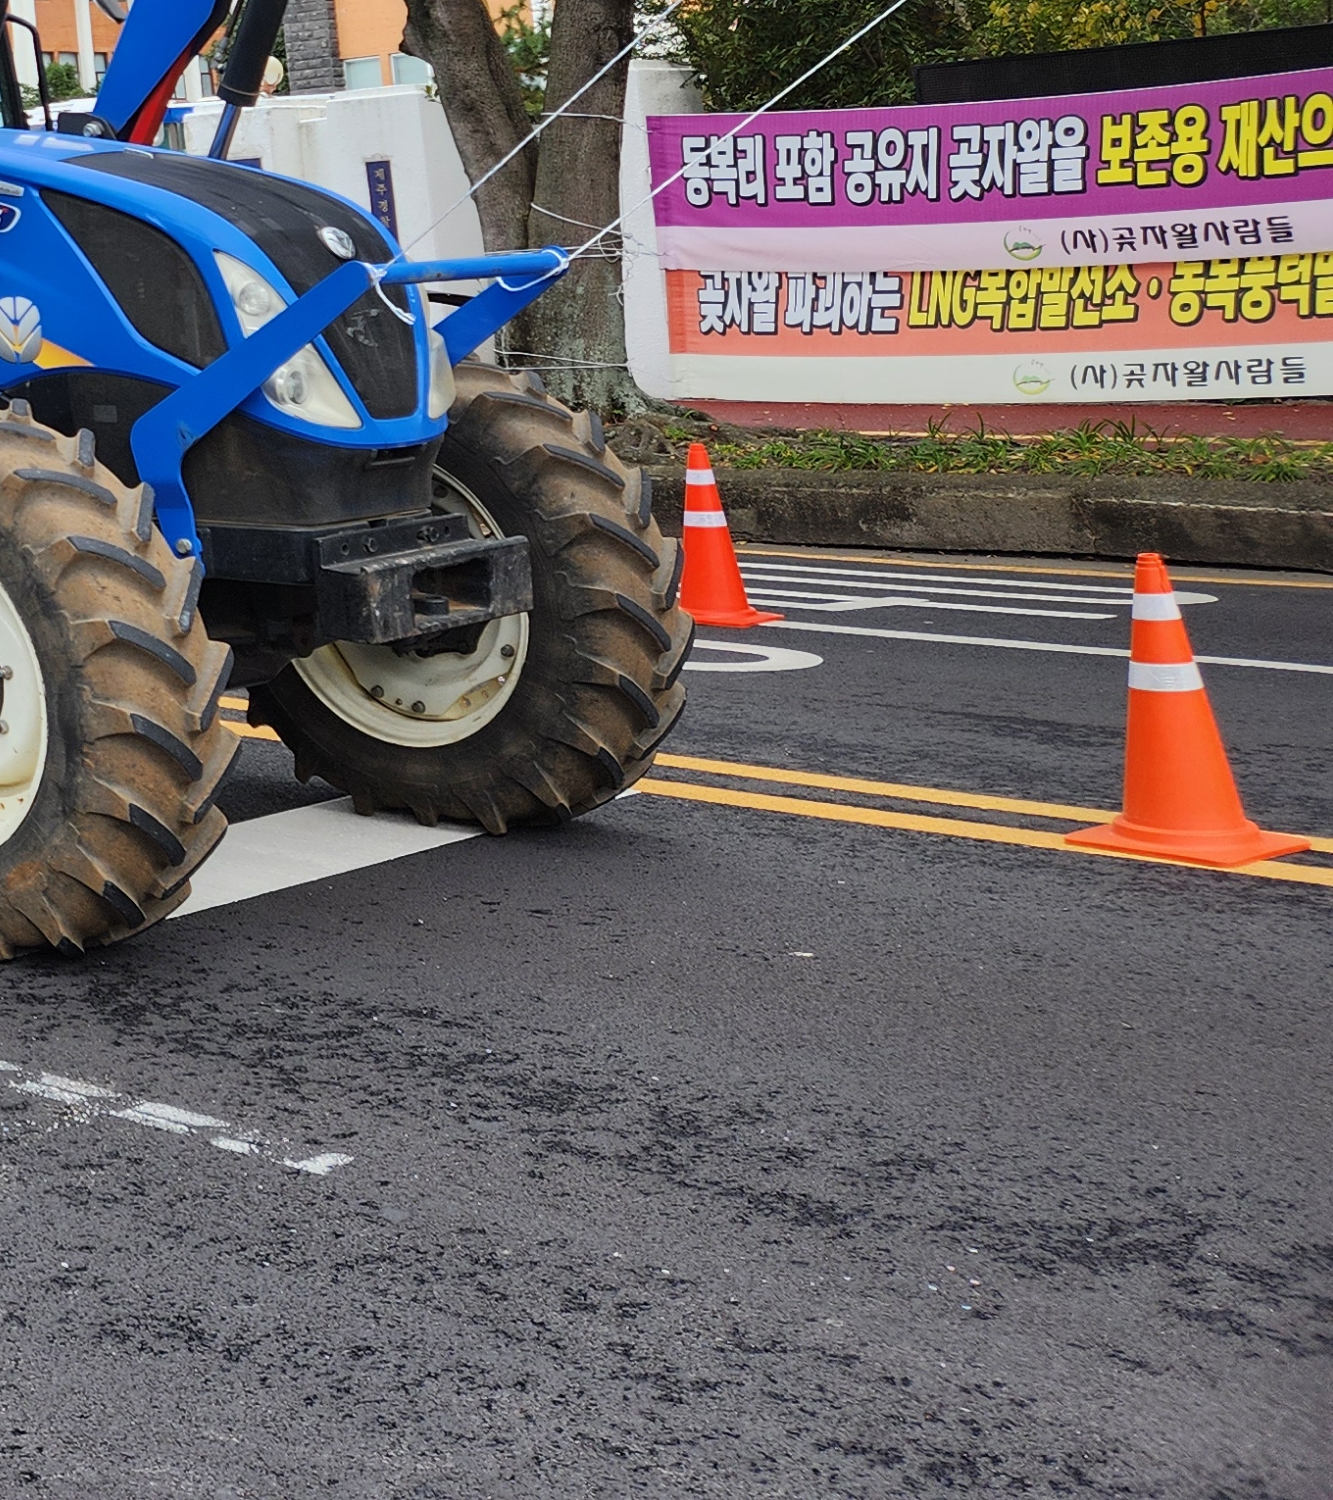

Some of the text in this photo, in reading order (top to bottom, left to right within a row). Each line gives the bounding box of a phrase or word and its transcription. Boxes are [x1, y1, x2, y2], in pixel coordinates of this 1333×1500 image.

[681, 134, 766, 206] 동복리
[774, 130, 836, 204] 포함
[843, 127, 939, 204] 공유지
[949, 116, 1088, 201] 곶자왈을
[1095, 105, 1209, 186] 보존용
[1060, 215, 1296, 255] (사)곶자왈사람들
[698, 271, 780, 334] 곶자왈
[785, 271, 903, 334] 파괴하는
[908, 264, 1138, 331] LNG복합발전소
[1070, 356, 1307, 391] (사)곶자왈사람들
